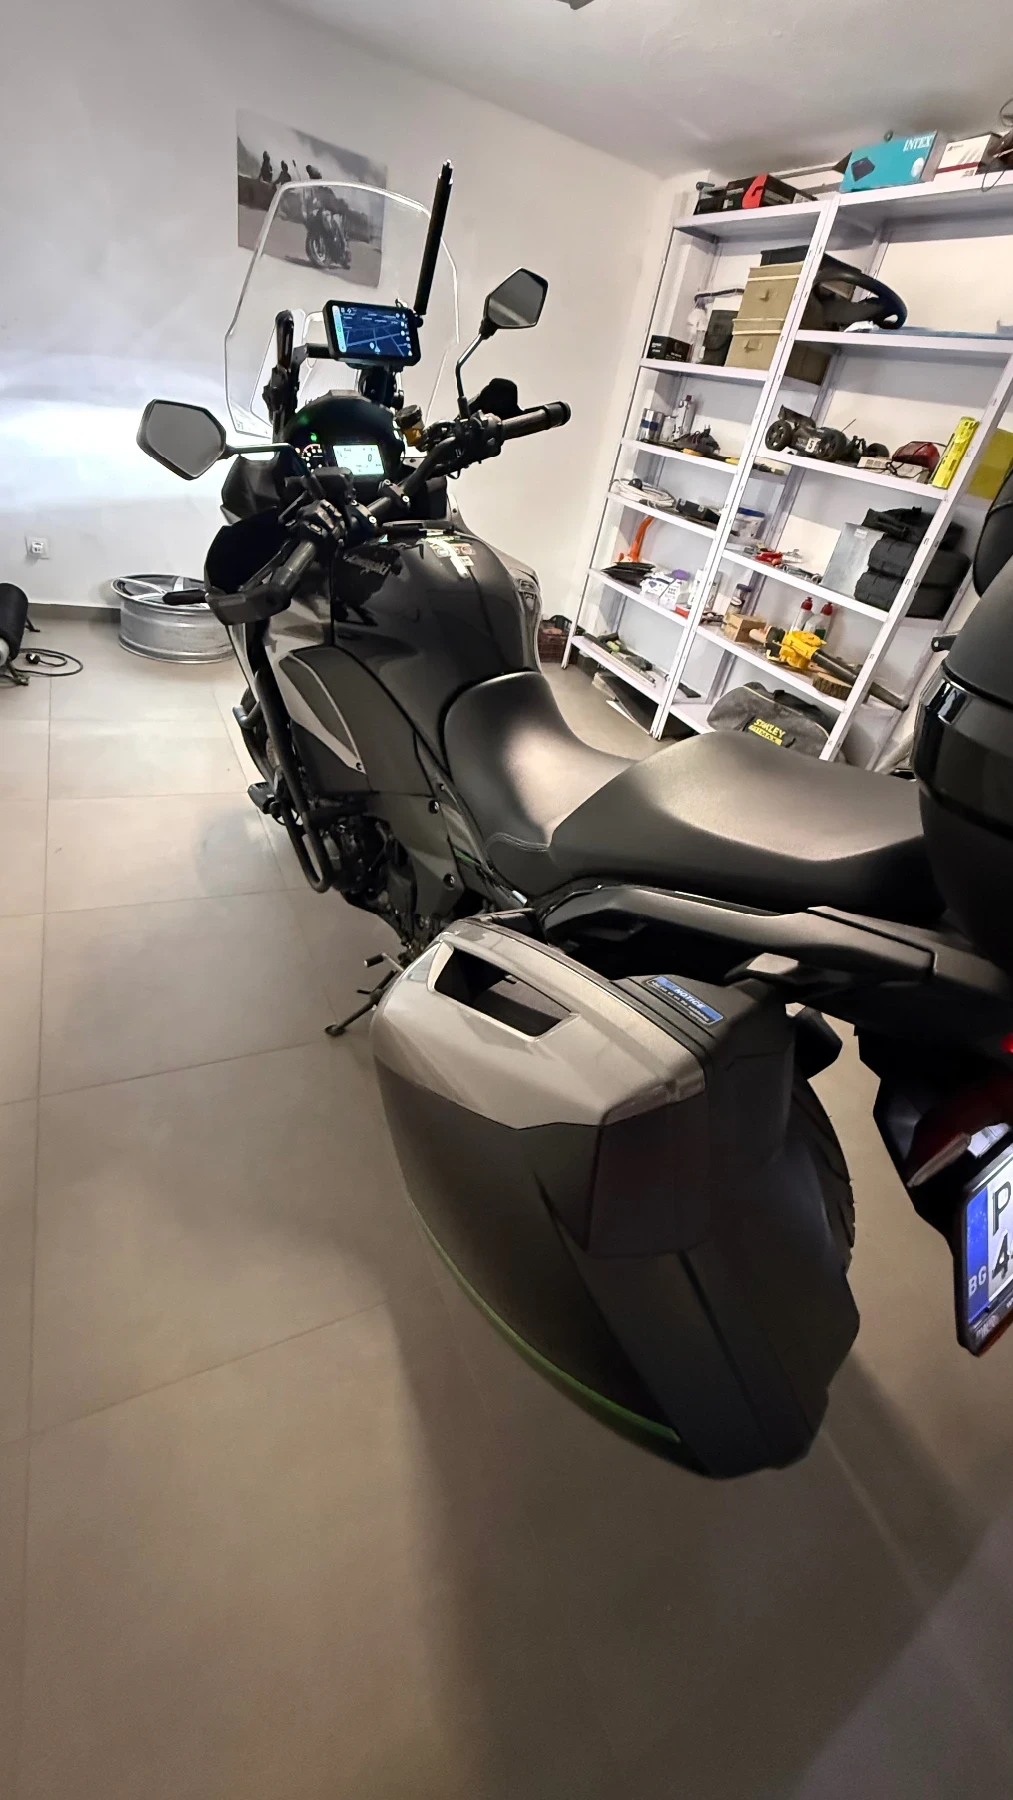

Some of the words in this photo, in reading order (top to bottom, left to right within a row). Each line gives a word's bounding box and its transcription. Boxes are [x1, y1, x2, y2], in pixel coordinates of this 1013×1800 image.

[903, 134, 934, 152] INTEX
[673, 988, 706, 1009] NOTICE
[992, 1181, 1012, 1237] P
[992, 1232, 1013, 1279] 4
[968, 1265, 987, 1298] BG
